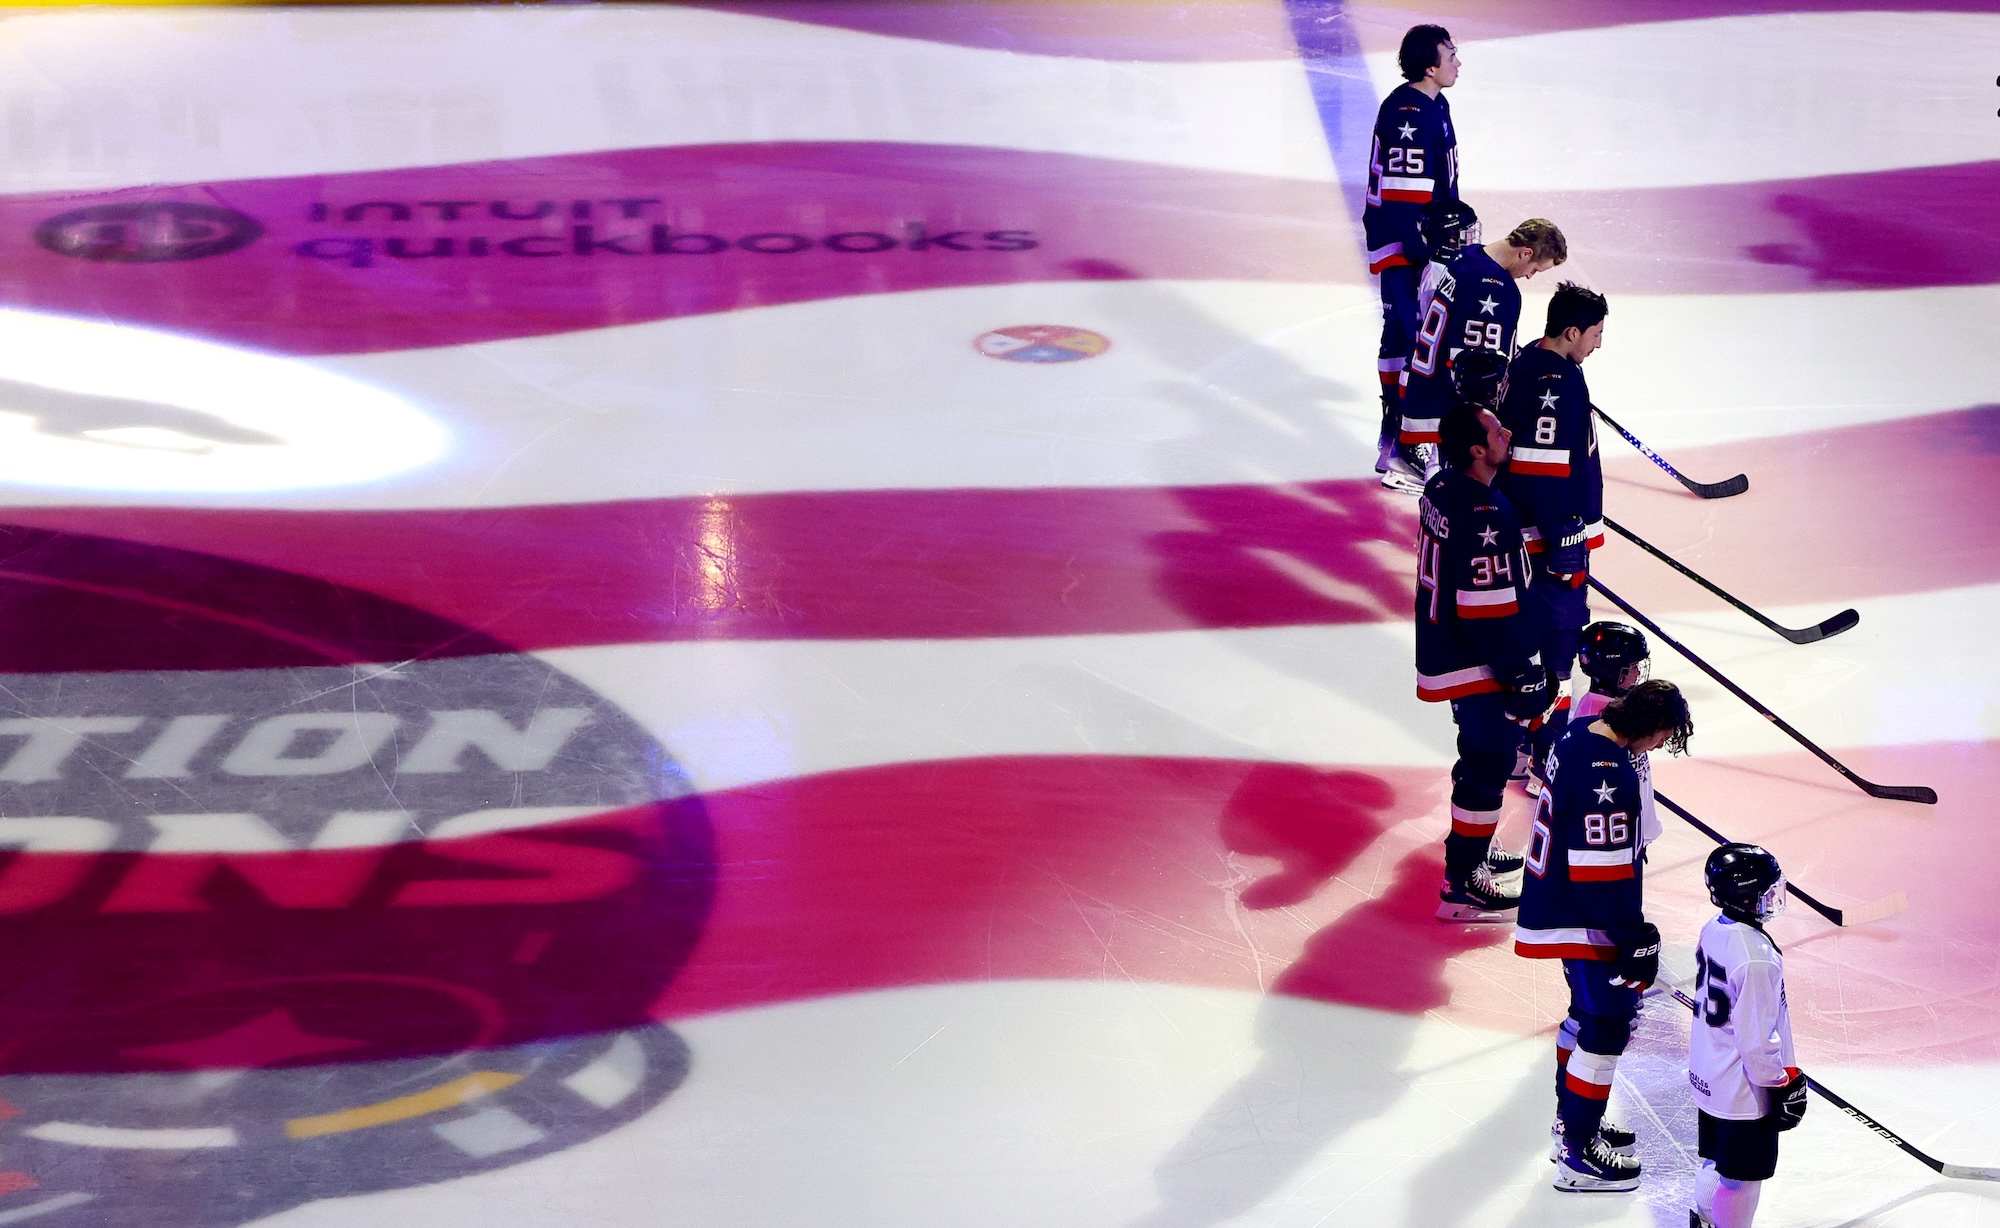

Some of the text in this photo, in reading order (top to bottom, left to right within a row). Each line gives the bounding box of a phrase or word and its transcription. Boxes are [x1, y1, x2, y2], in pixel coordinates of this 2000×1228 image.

[1388, 146, 1425, 174] 25
[309, 198, 660, 222] INTUIT
[295, 221, 1040, 268] quickbooks
[1464, 319, 1502, 350] 59
[1535, 415, 1557, 445] 8
[1470, 552, 1513, 587] 34
[1584, 811, 1629, 845] 86
[1843, 1106, 1903, 1147] BAUER
